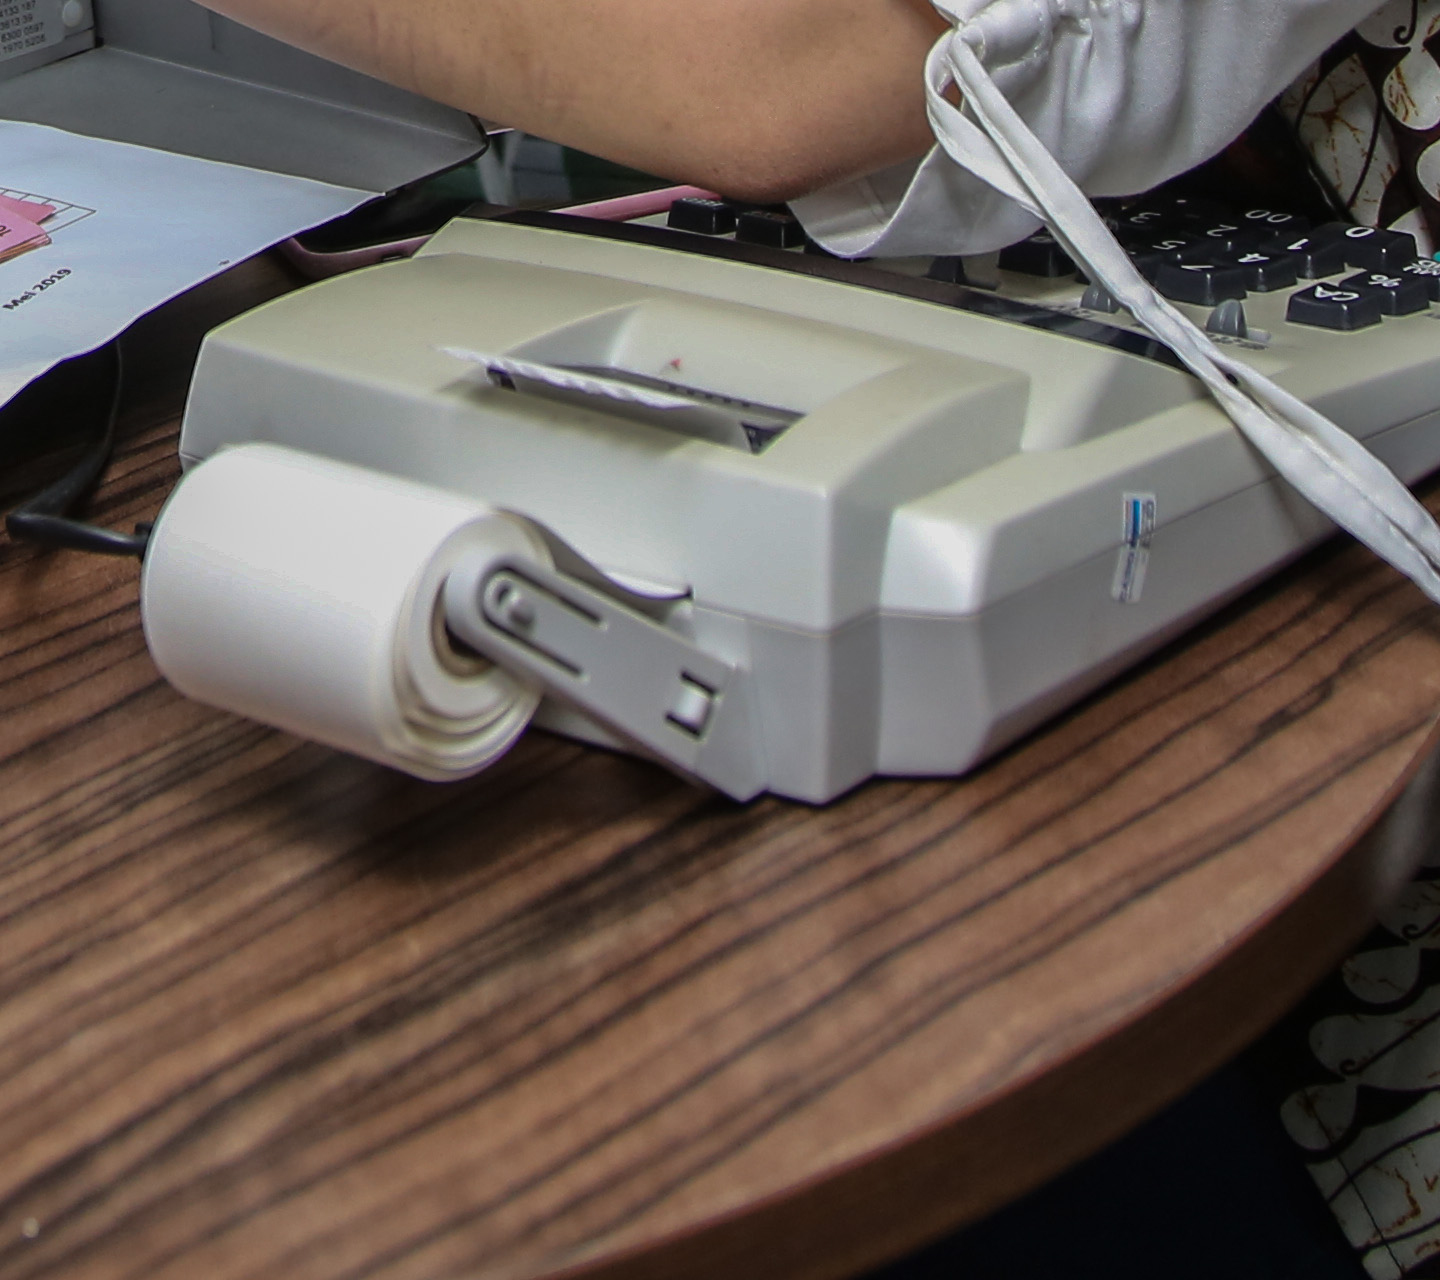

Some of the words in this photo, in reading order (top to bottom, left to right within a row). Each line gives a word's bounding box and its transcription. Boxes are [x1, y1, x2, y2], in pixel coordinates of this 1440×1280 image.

[1245, 209, 1293, 223] 00
[1207, 224, 1238, 237] 2
[1345, 226, 1375, 238] 0
[1238, 253, 1270, 263] 4
[2, 290, 37, 311] Mei
[31, 267, 72, 292] 2019
[1314, 286, 1360, 302] CA
